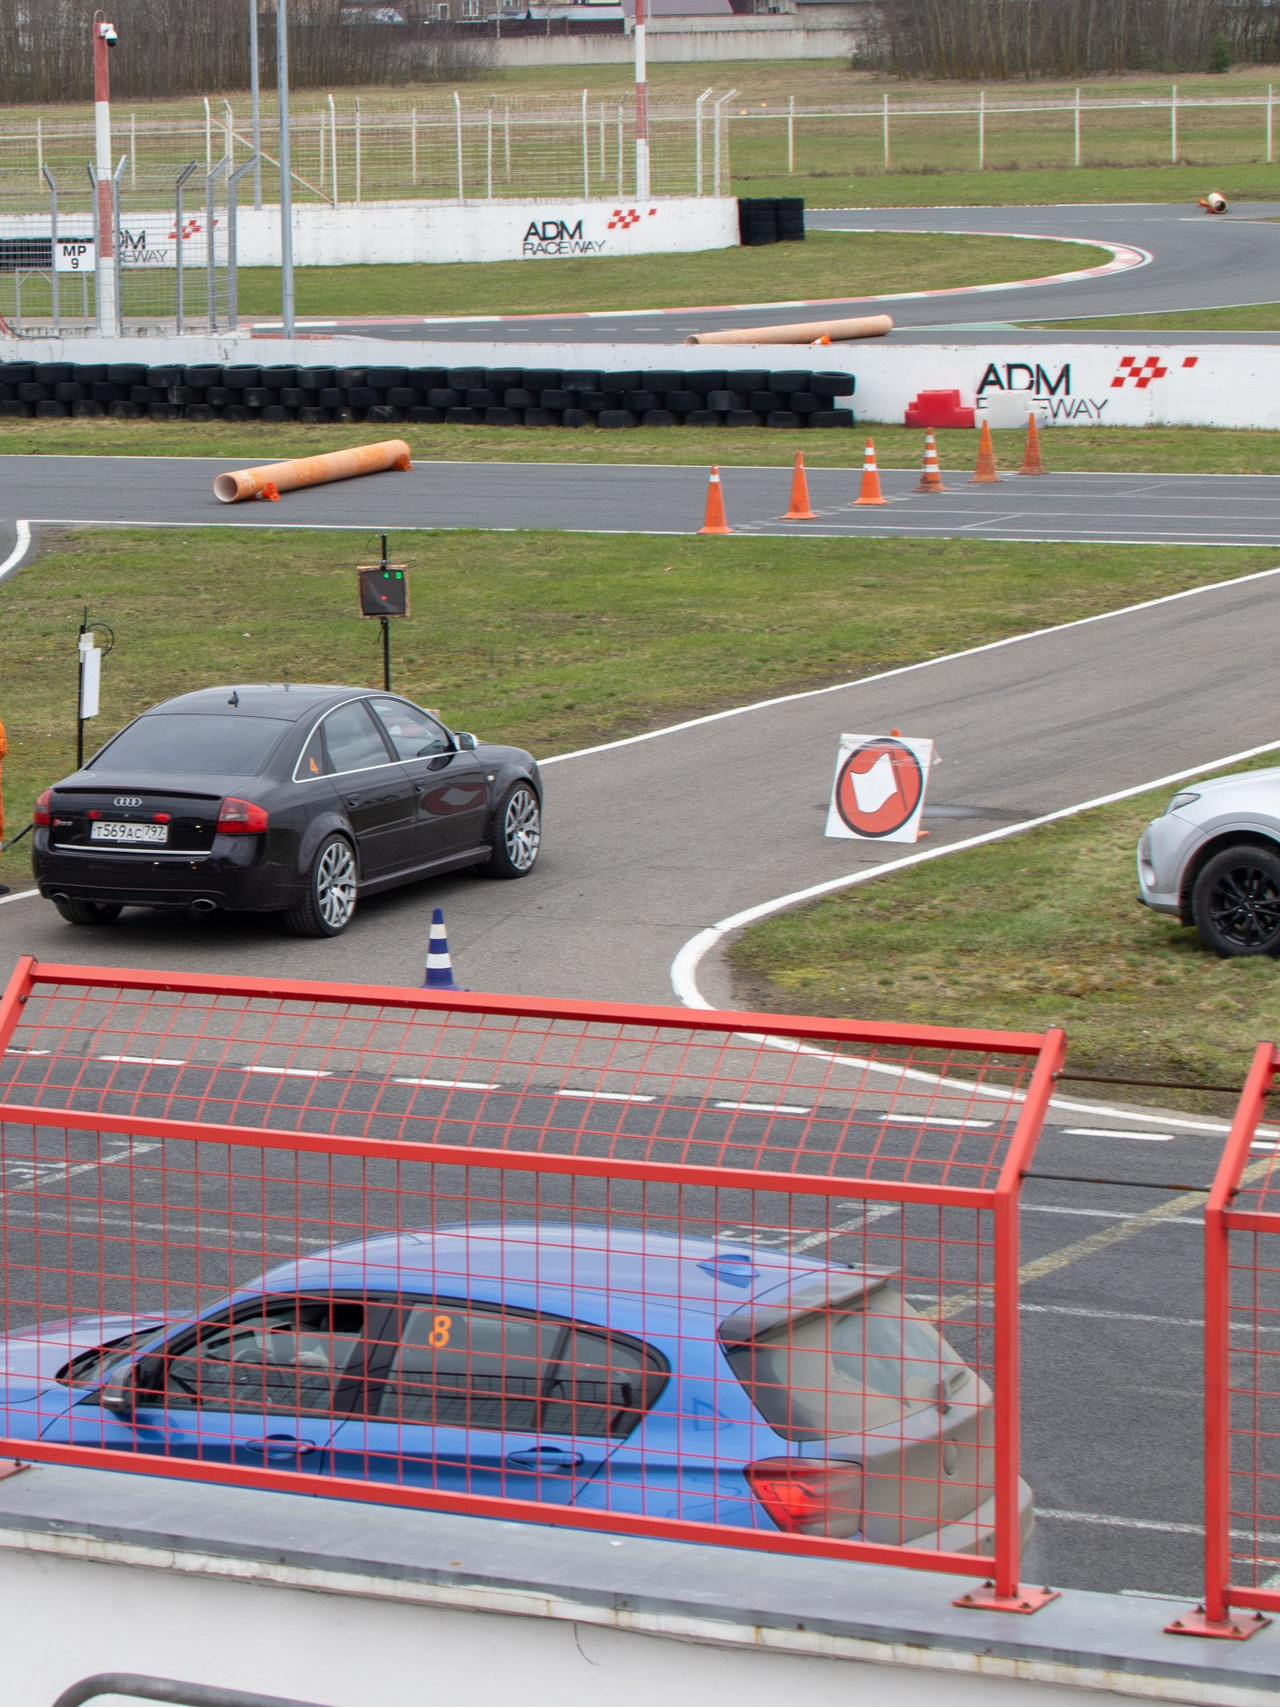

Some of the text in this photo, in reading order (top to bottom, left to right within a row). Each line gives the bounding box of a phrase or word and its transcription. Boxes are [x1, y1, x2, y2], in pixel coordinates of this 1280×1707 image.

[523, 219, 583, 242] ADM
[63, 245, 87, 257] MP
[522, 240, 606, 256] RACEWAY
[70, 257, 79, 269] 9
[976, 363, 1071, 396] ADM
[429, 1315, 452, 1348] 8
